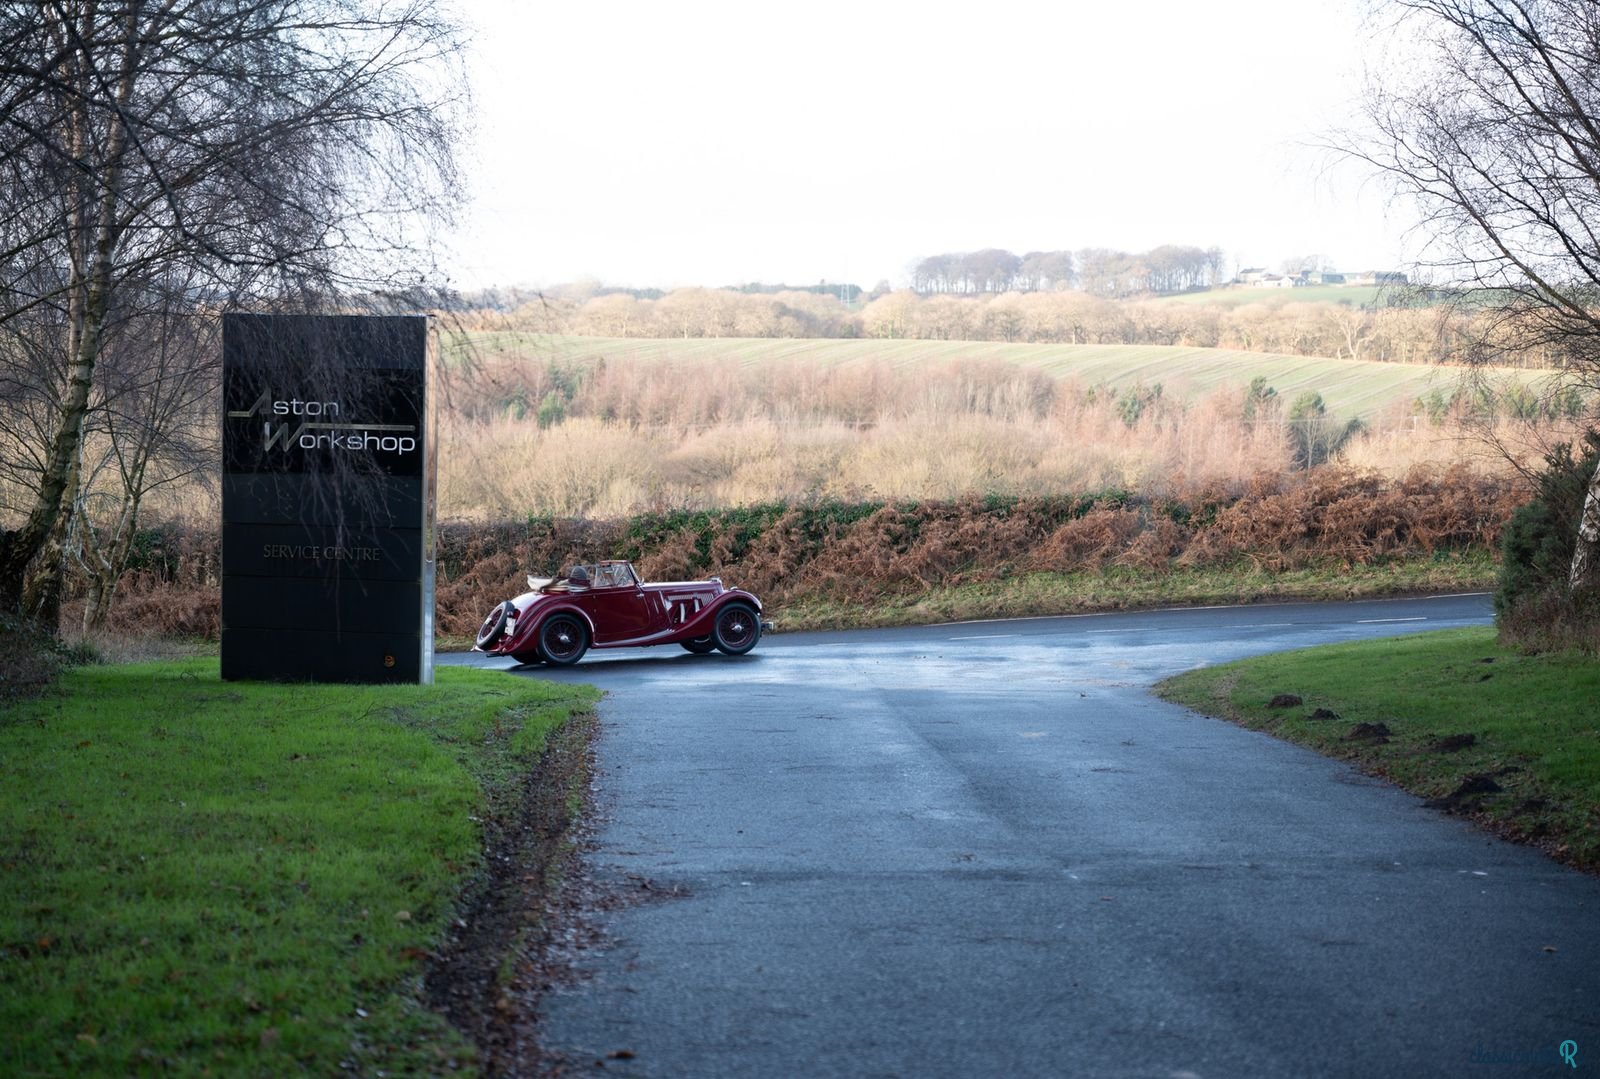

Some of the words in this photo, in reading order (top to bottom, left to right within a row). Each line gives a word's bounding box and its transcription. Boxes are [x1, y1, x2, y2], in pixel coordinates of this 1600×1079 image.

[228, 387, 339, 417] Aston
[264, 421, 416, 455] Workshop
[263, 544, 320, 559] SERVICE
[323, 546, 380, 561] CENTRE
